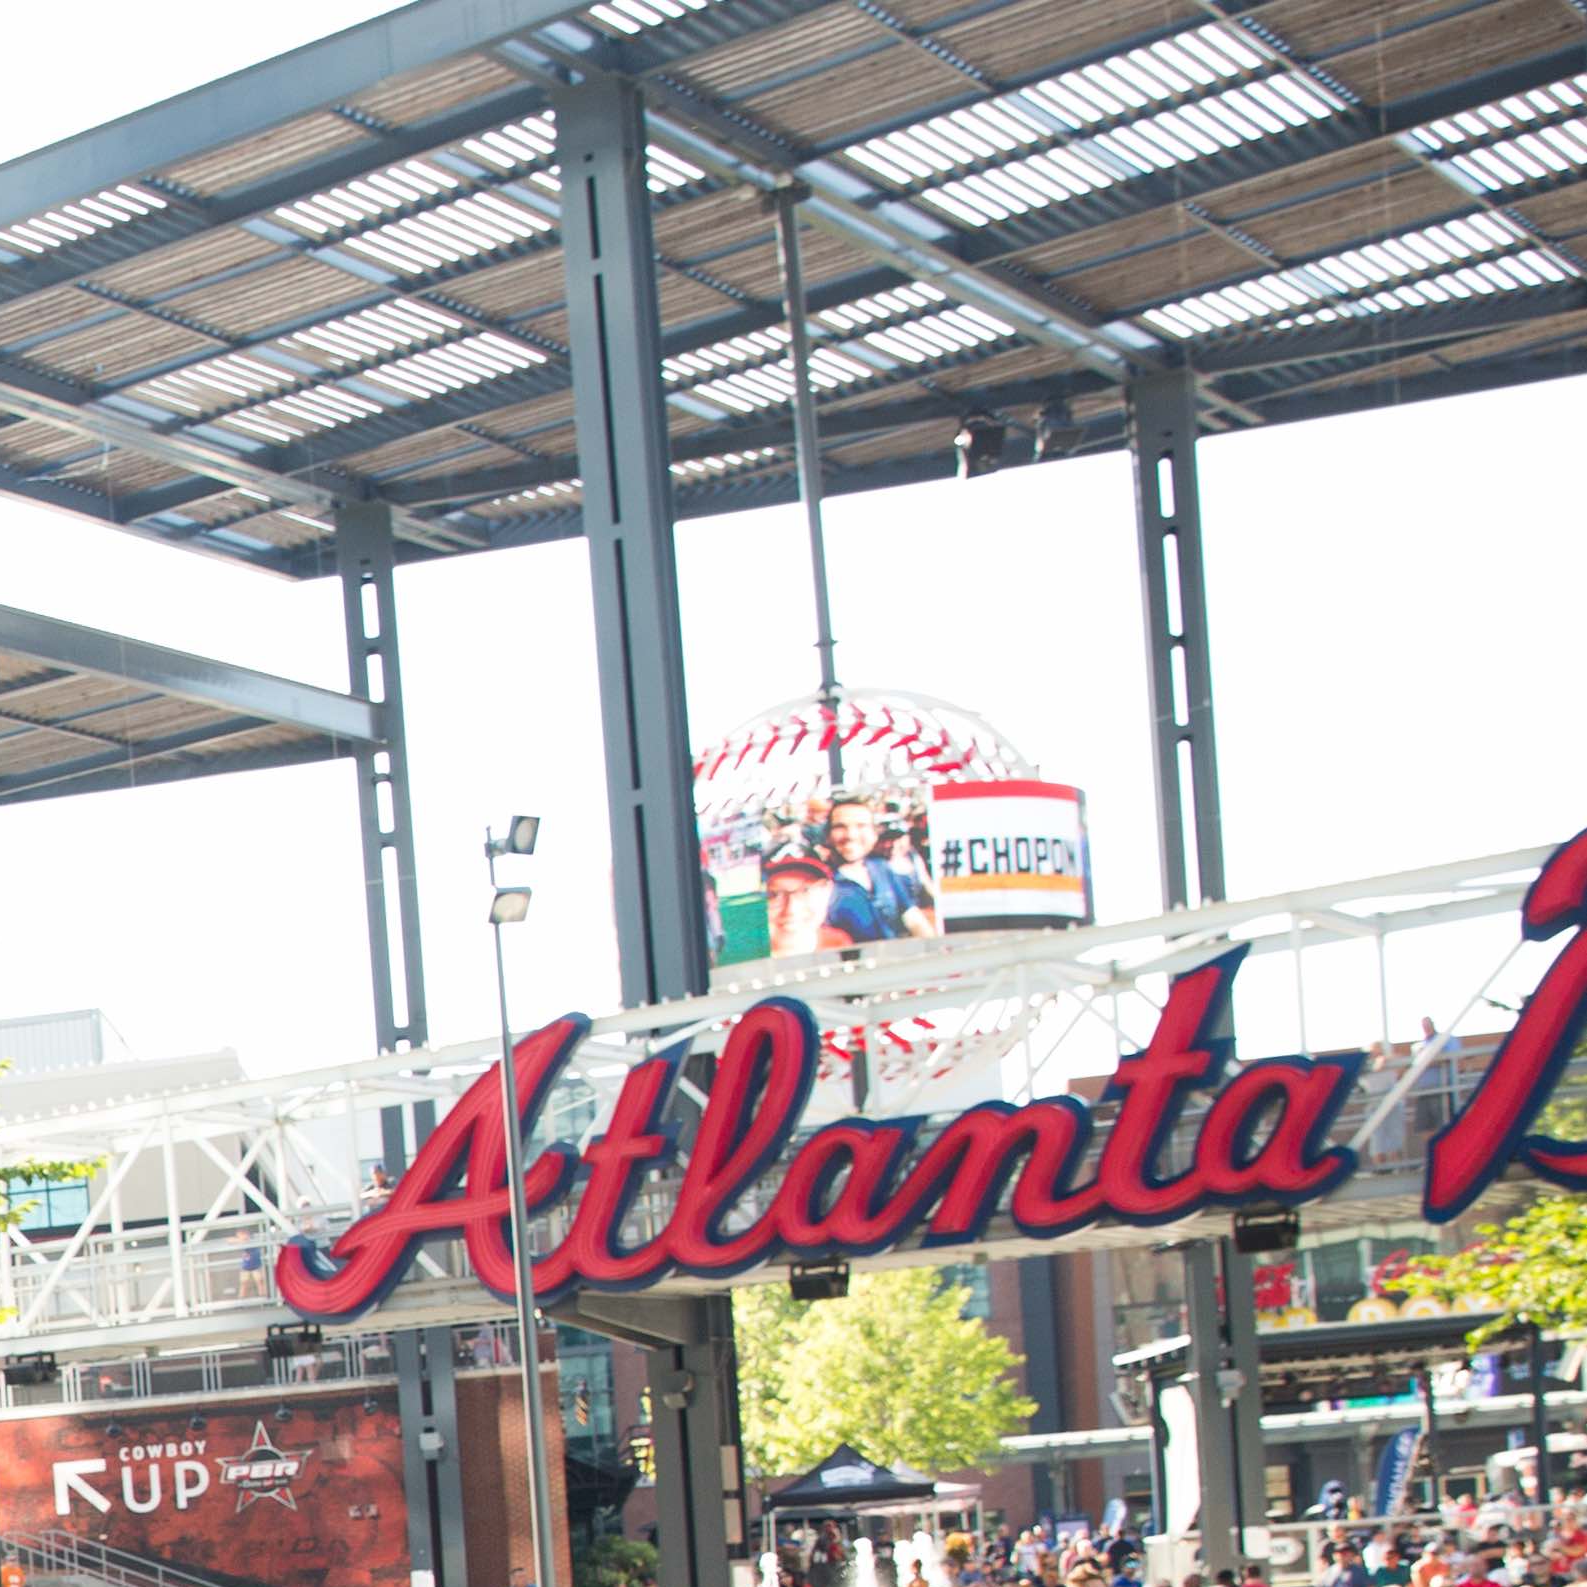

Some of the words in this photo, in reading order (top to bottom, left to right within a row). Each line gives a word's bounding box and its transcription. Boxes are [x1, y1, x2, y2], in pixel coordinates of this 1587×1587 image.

[941, 837, 1077, 877] #CHOPON
[275, 943, 1360, 1325] Atlanta
[119, 1441, 207, 1463] COWBOY
[227, 1461, 299, 1480] PBR
[121, 1461, 210, 1514] UP
